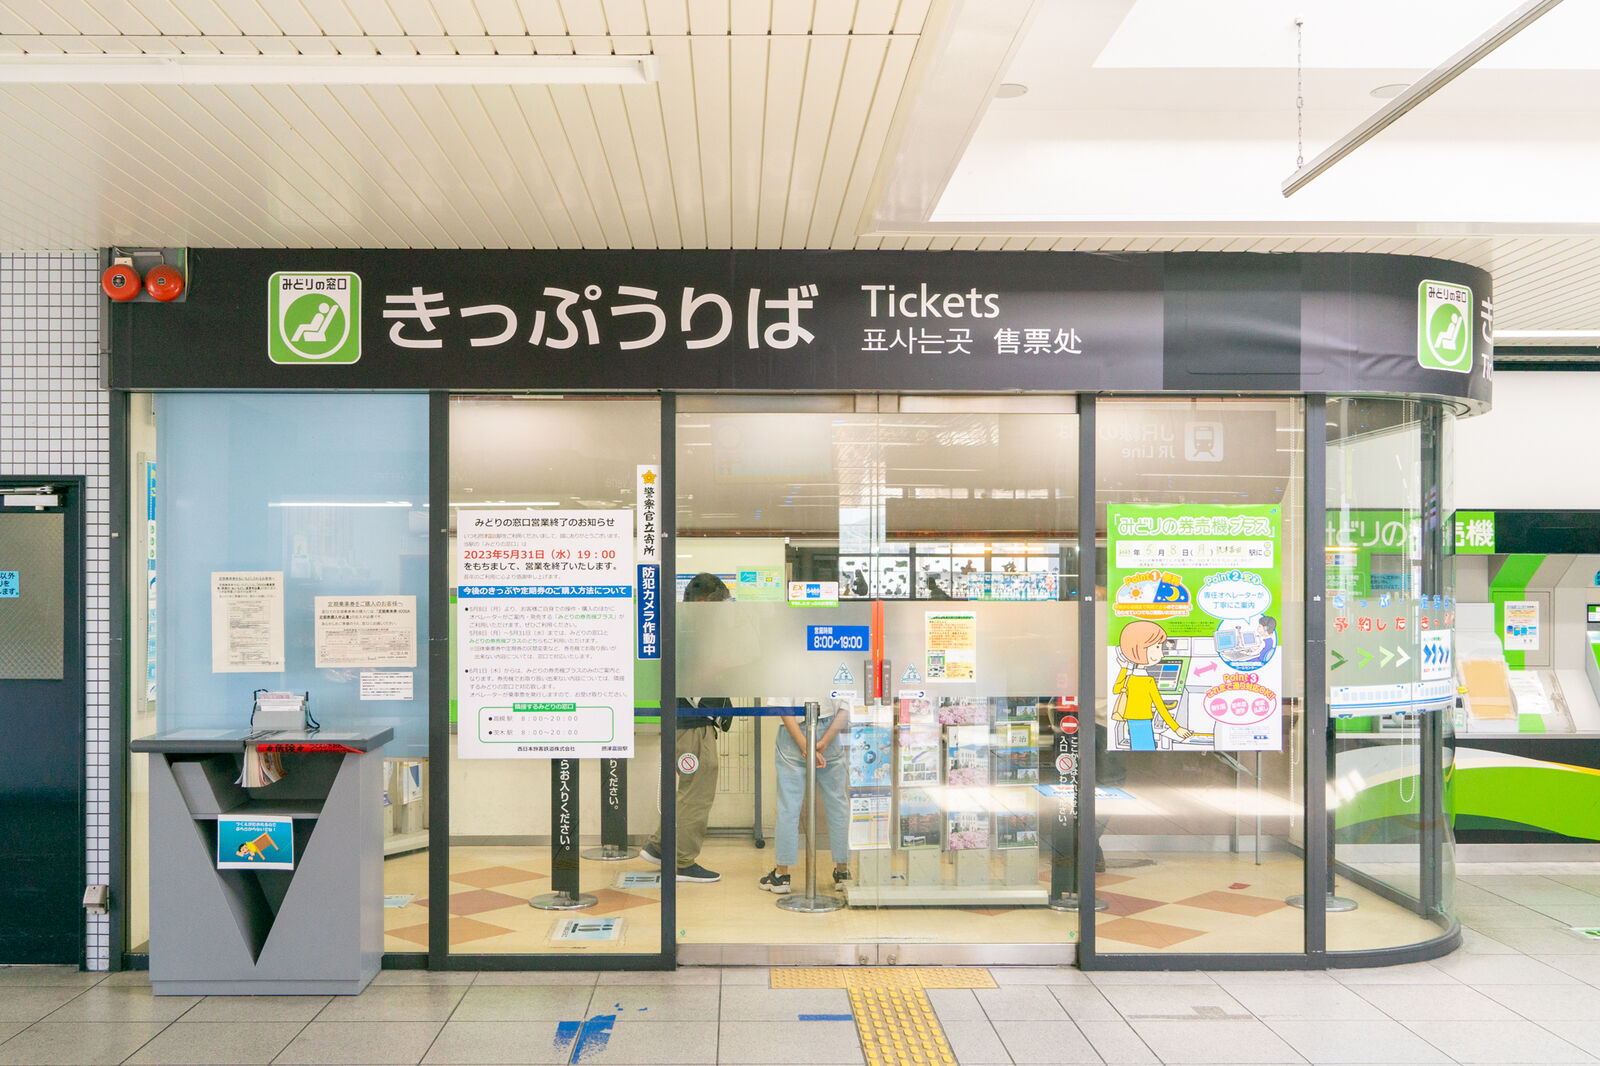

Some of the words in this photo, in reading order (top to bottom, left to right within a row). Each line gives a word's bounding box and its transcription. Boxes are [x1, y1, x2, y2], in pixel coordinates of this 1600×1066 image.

[282, 278, 347, 290] みどりの窓口
[1428, 286, 1467, 303] みどりの窓口
[861, 283, 1000, 318] Tickets
[382, 284, 819, 350] きっぷうりば
[861, 327, 974, 354] 표사는곳
[993, 327, 1082, 354] 售票处
[475, 517, 615, 528] みどりの窓口営業終了のお知らせ
[643, 487, 655, 556] 警察官立寄所
[464, 562, 617, 571] をもちまして、営業を終了いたします。
[463, 587, 627, 595] 今後のきっぷや定期券のご購入方法について
[642, 566, 656, 656] 防犯カメラ作動中
